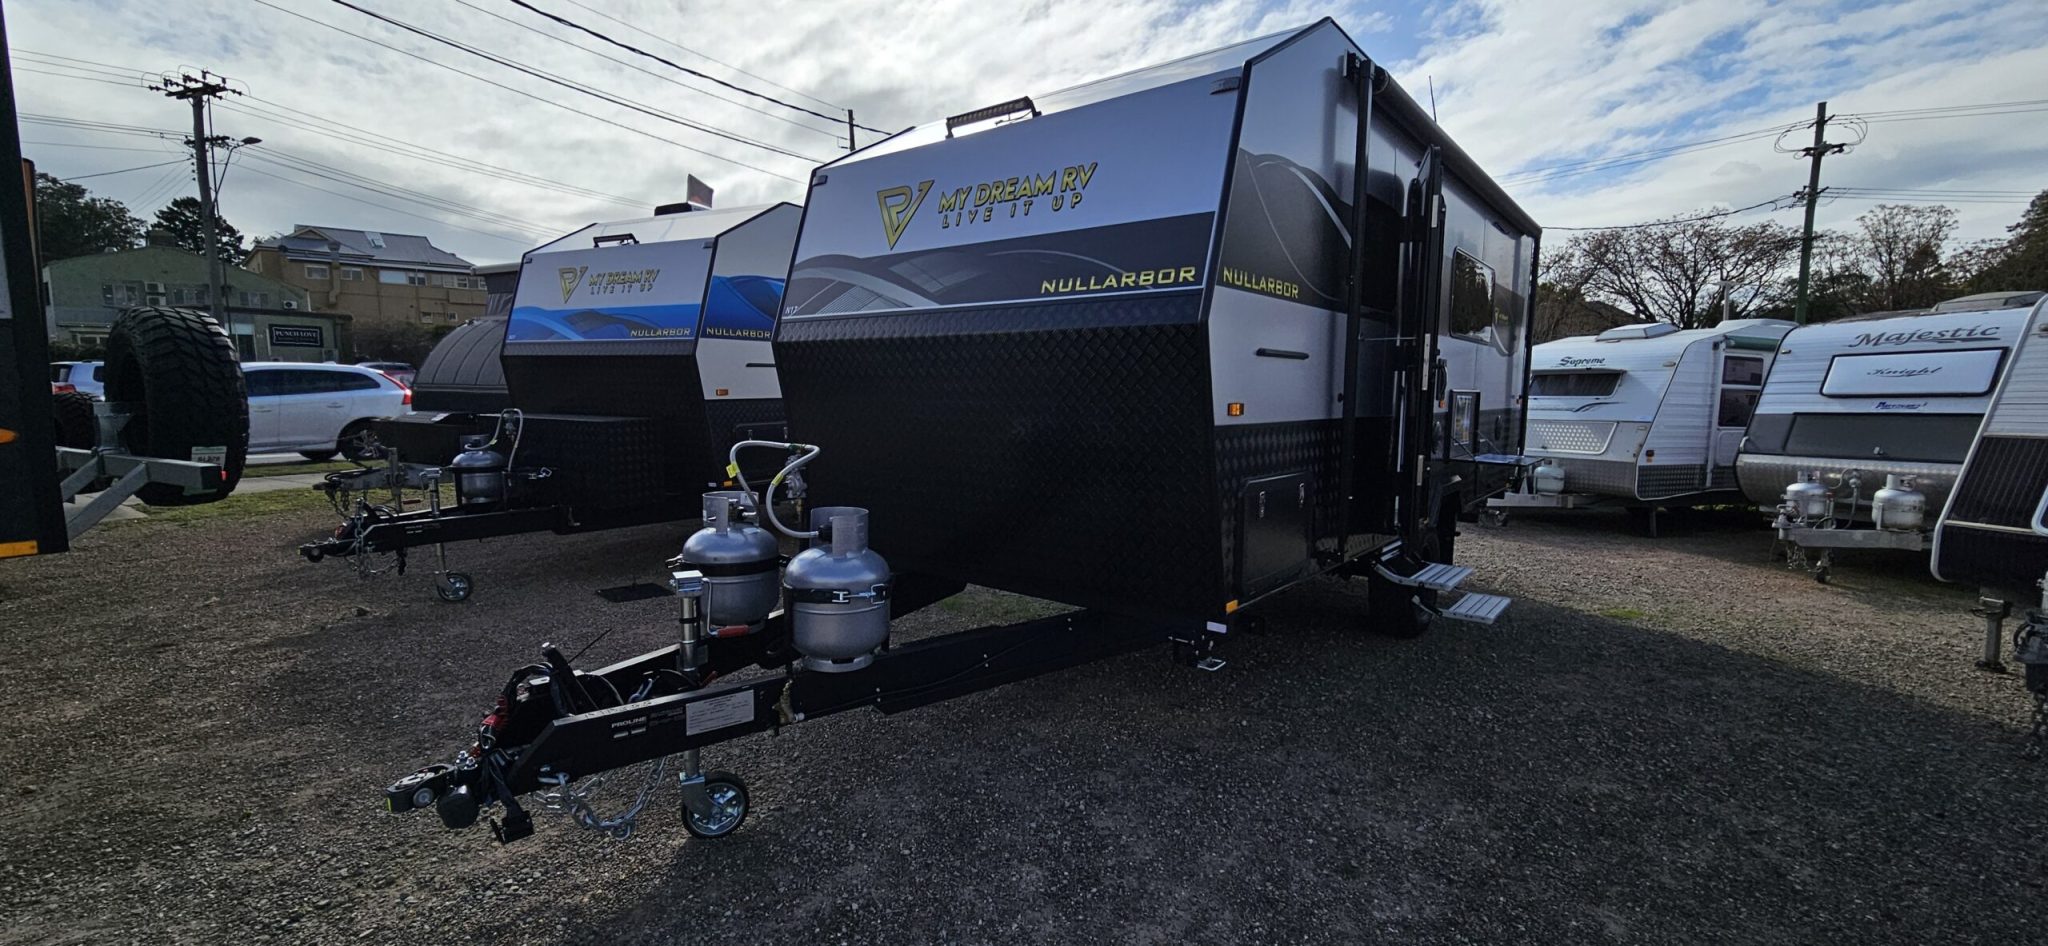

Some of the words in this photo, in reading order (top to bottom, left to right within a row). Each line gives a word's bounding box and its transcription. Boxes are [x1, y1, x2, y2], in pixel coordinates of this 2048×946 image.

[938, 186, 973, 213] MY
[974, 170, 1056, 206] DREAM
[1061, 162, 1099, 192] RV
[941, 207, 993, 229] LIVE
[1010, 200, 1034, 218] IT
[1052, 193, 1083, 211] UP
[589, 273, 606, 287] MY
[606, 270, 643, 286] DREAM
[643, 268, 660, 283] RV
[1040, 266, 1196, 294] NULLARBOR
[1222, 267, 1300, 299] NULLARBOR
[590, 286, 615, 295] LIVE
[621, 284, 633, 294] IT
[640, 283, 653, 292] UP
[630, 327, 691, 337] NULLARBOR
[706, 327, 771, 339] NULLARBOR
[1847, 324, 2001, 347] Majestic
[1558, 356, 1606, 367] Supreme
[1866, 366, 1943, 377] Knight
[611, 716, 647, 729] PROLINE
